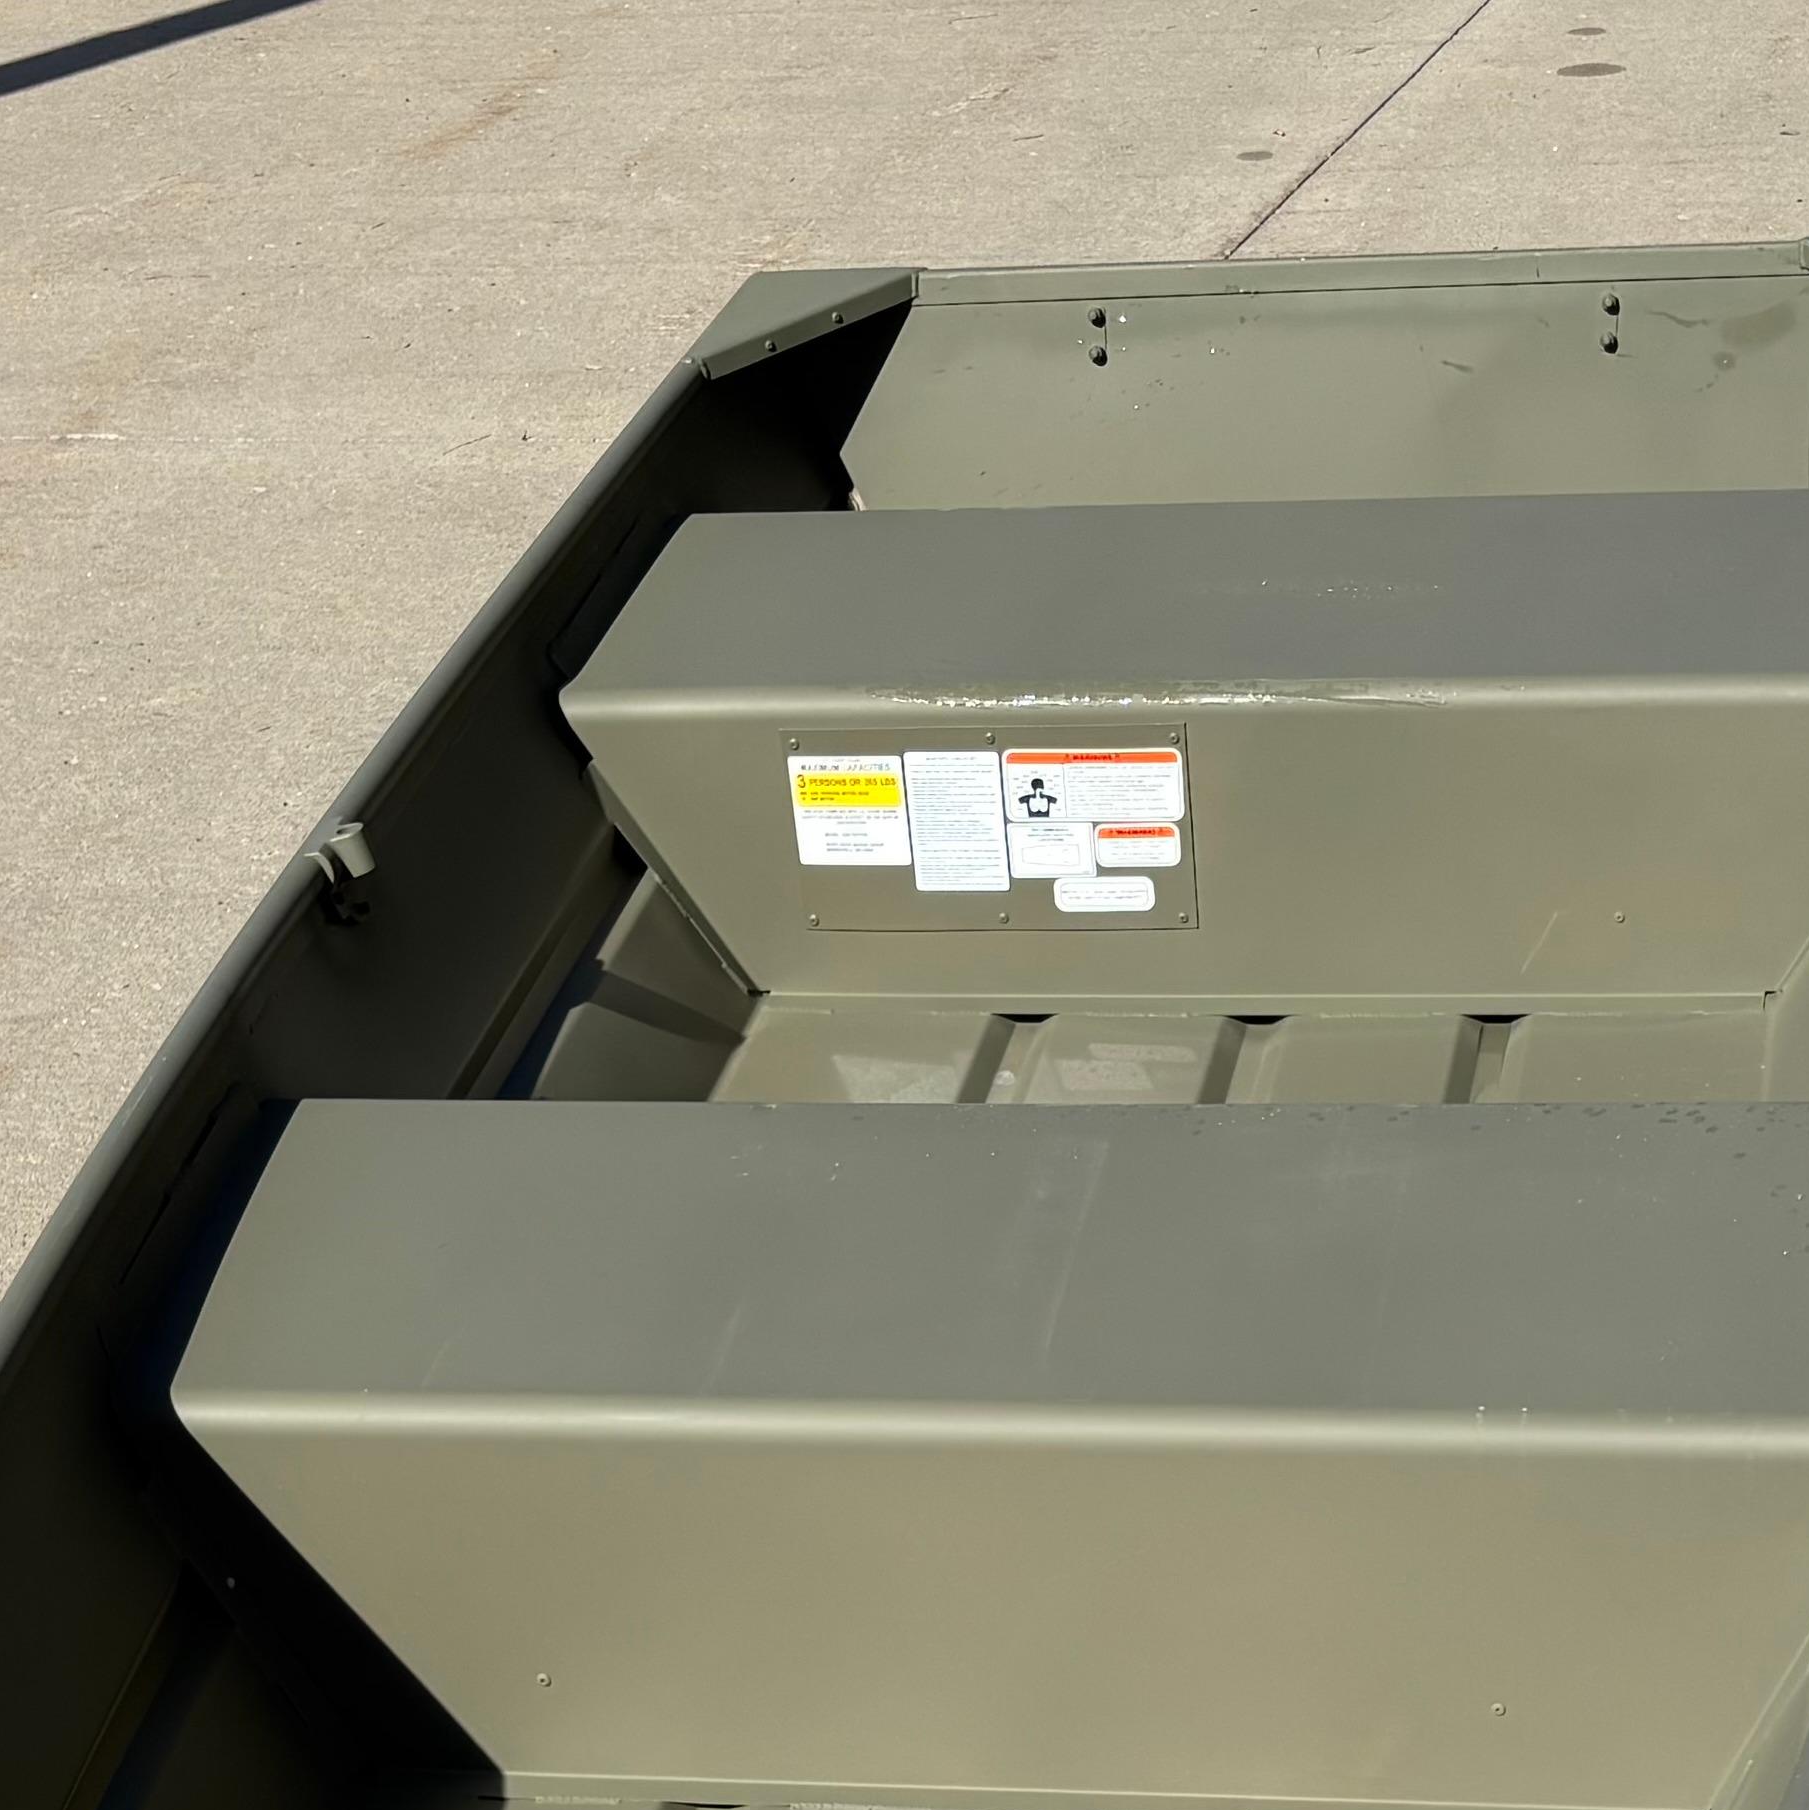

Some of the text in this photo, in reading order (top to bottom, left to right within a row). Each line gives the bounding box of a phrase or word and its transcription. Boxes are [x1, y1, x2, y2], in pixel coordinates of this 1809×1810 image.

[843, 763, 891, 771] APACITIES
[797, 774, 806, 788] 3
[809, 778, 847, 786] PERSONS
[849, 778, 861, 786] OR
